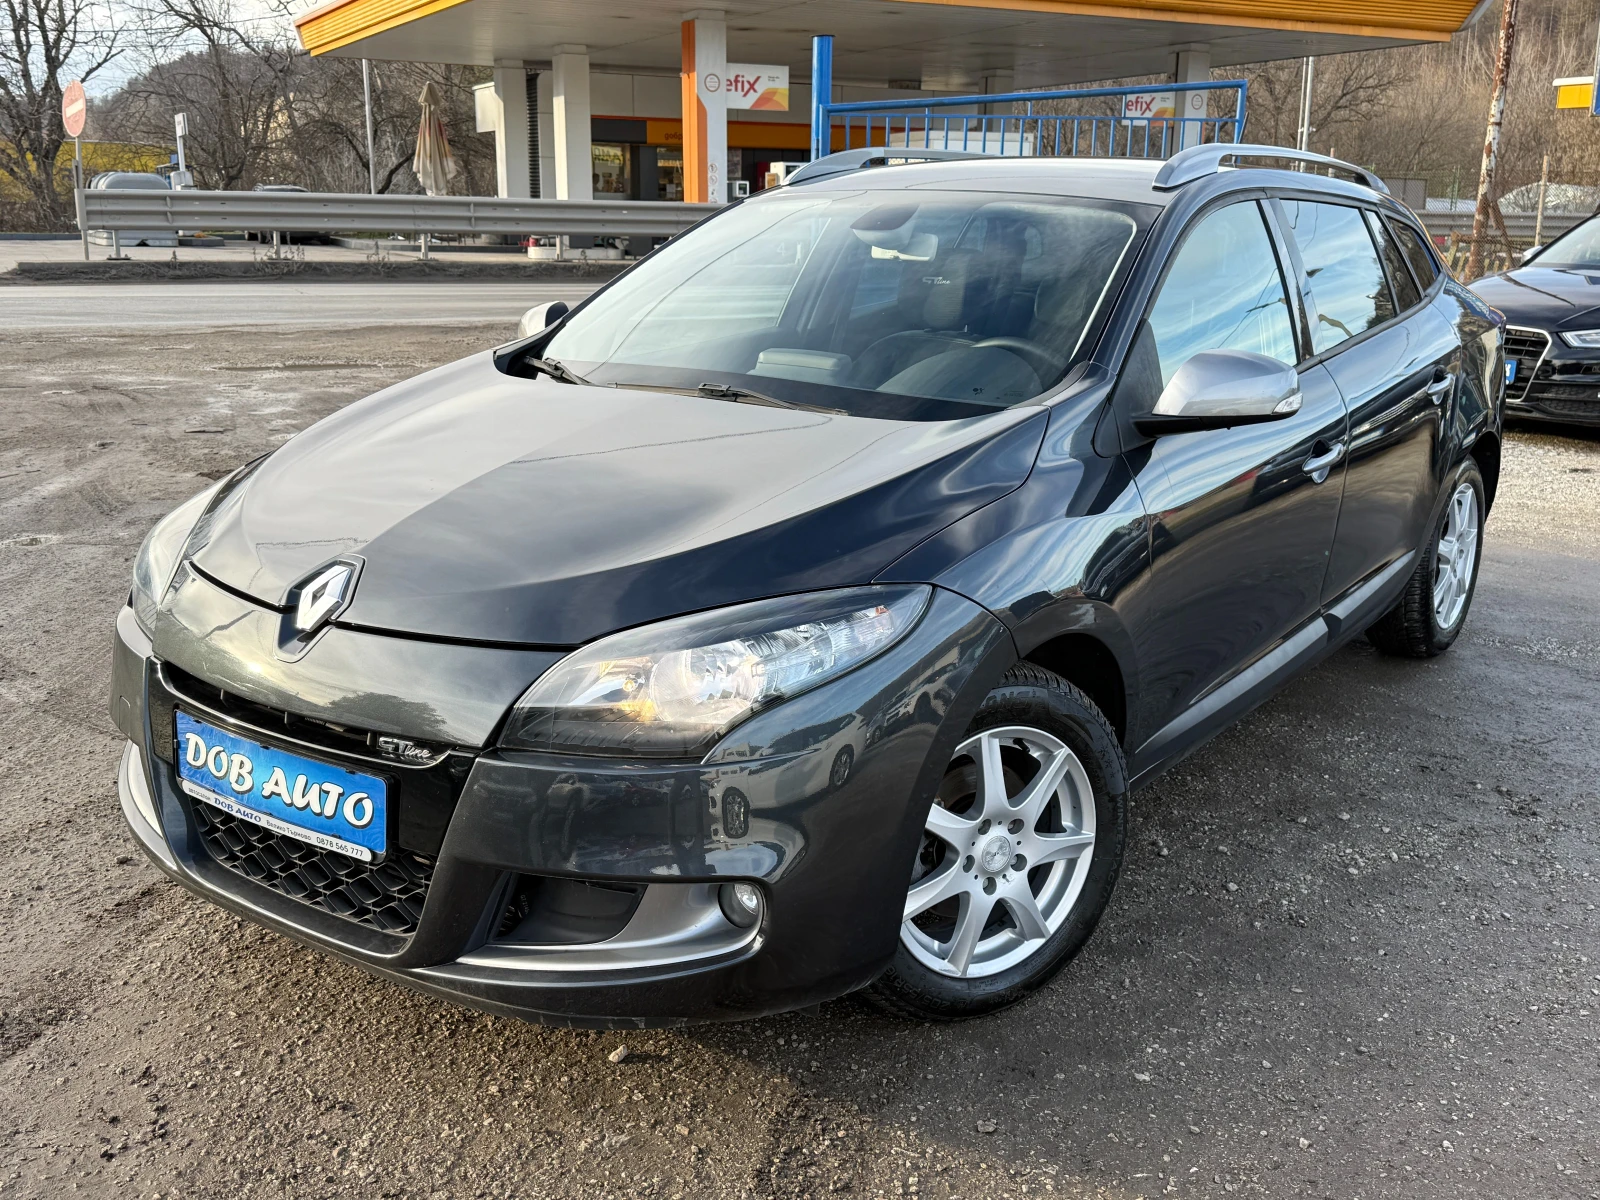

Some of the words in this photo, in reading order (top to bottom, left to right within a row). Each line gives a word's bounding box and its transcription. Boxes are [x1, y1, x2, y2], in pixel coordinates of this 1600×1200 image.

[726, 74, 762, 98] efix
[1125, 95, 1156, 116] efix
[185, 732, 254, 795] DOB
[261, 766, 374, 829] AUTO
[213, 797, 234, 812] DOB
[235, 807, 262, 823] AUTO
[1114, 794, 1125, 855] WINTER
[316, 836, 334, 848] 0878
[335, 843, 349, 853] 565
[350, 847, 364, 857] 777
